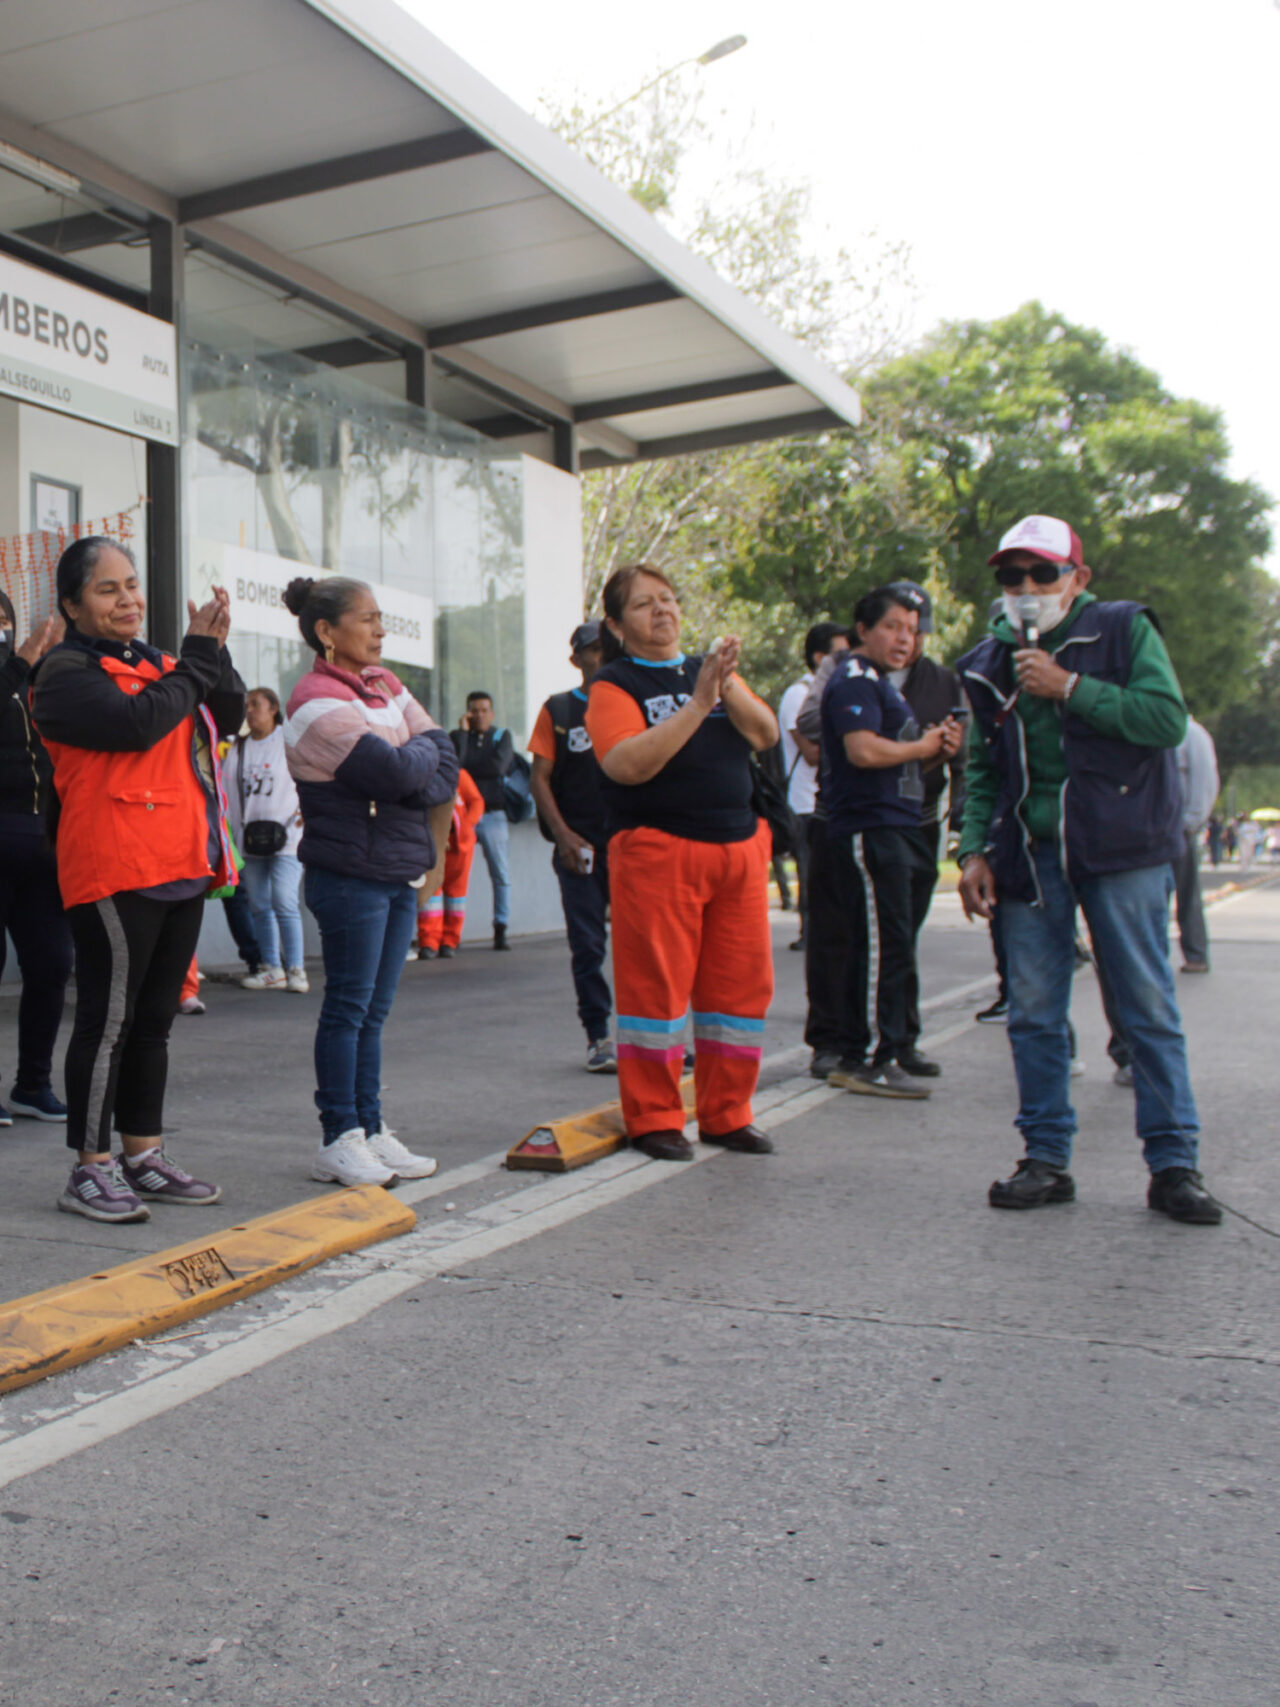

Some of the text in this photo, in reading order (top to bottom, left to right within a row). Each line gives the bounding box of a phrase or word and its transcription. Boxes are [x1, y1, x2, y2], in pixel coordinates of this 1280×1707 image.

[142, 354, 170, 377] RUTA
[236, 577, 288, 610] BOMBE
[382, 612, 422, 641] BEROS
